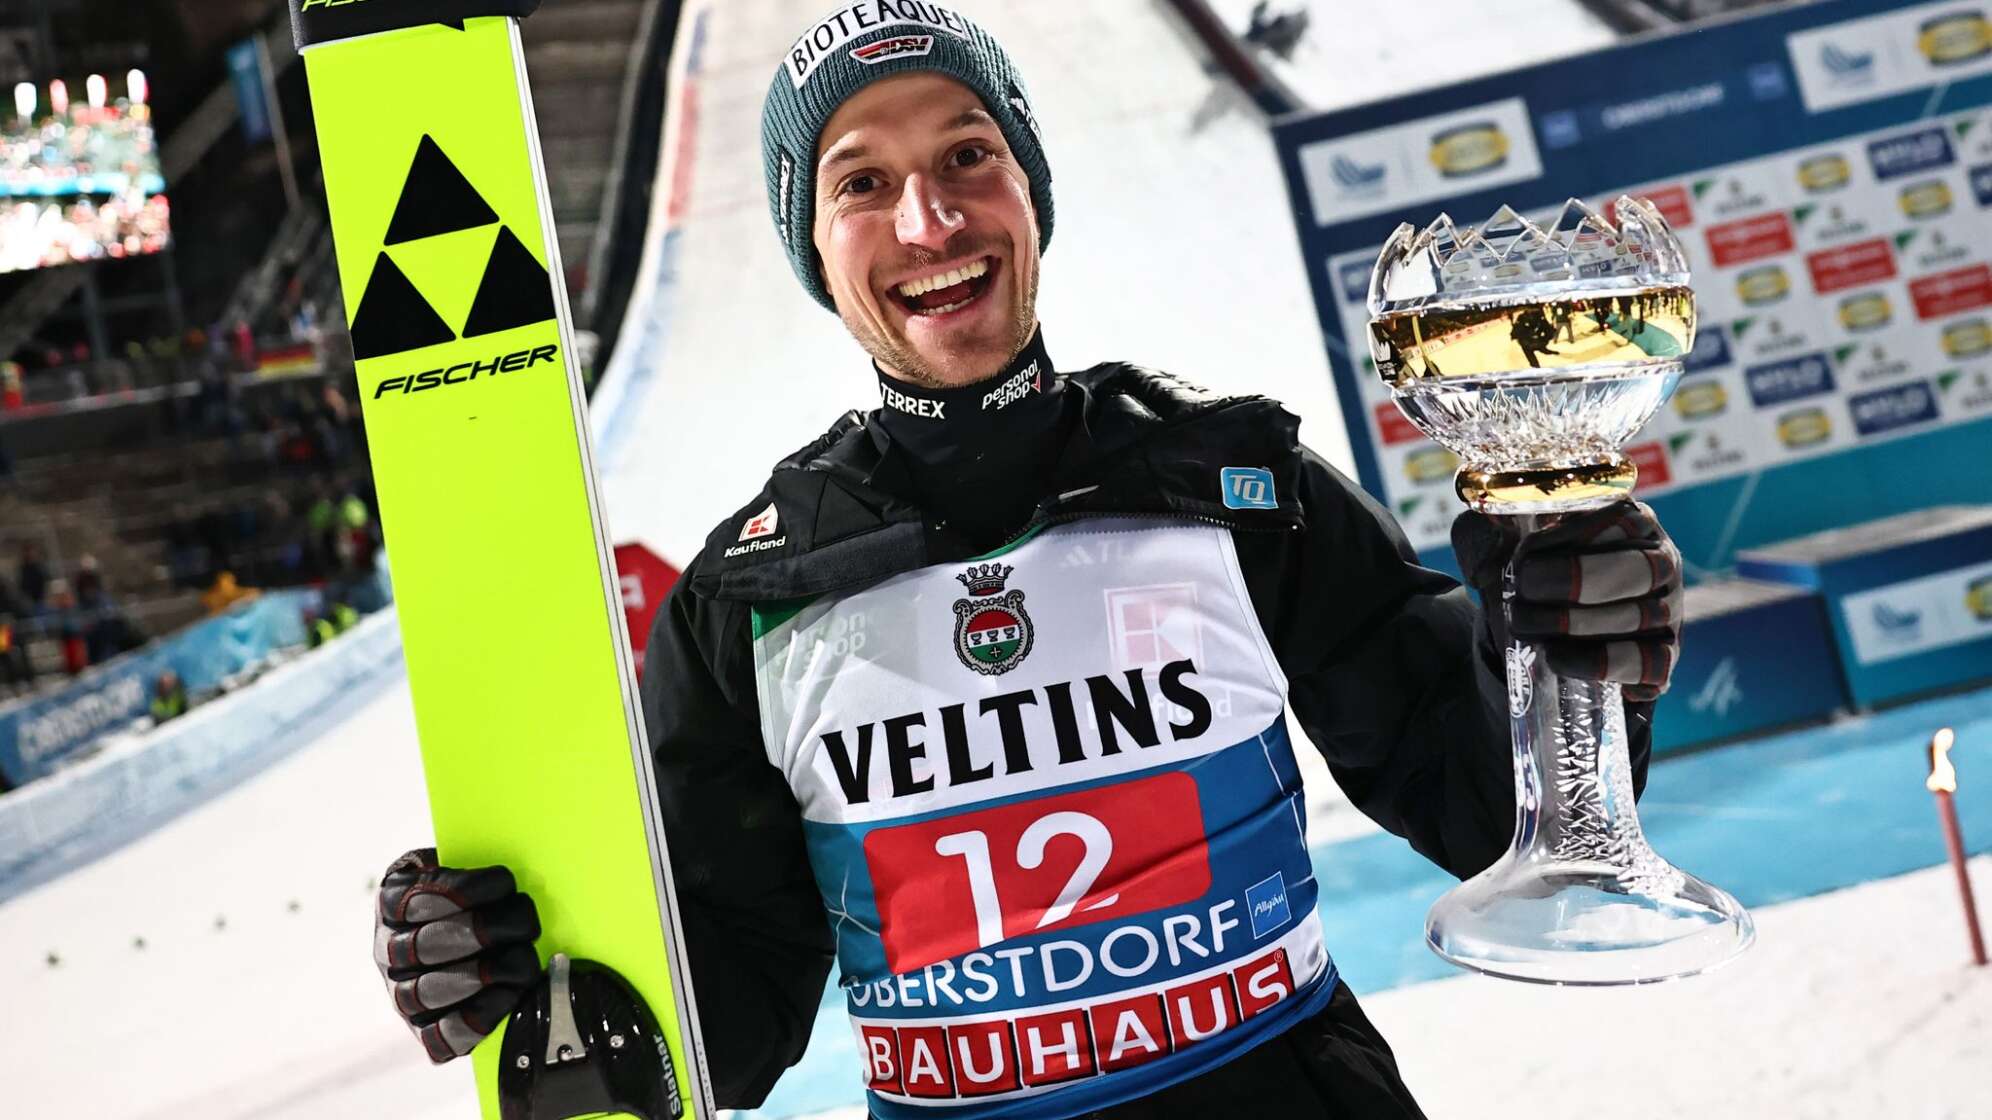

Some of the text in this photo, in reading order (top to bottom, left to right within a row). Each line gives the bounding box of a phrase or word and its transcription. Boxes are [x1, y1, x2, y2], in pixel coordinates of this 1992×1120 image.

[791, 0, 963, 77] BIOTEAQUE
[373, 344, 558, 400] FISCHER
[981, 358, 1039, 410] personal
[996, 382, 1031, 410] shop
[881, 382, 945, 420] TERREX
[1229, 474, 1265, 505] TQ
[723, 535, 787, 558] Kaufland
[820, 657, 1212, 806] VELTINS
[934, 811, 1120, 948] 12
